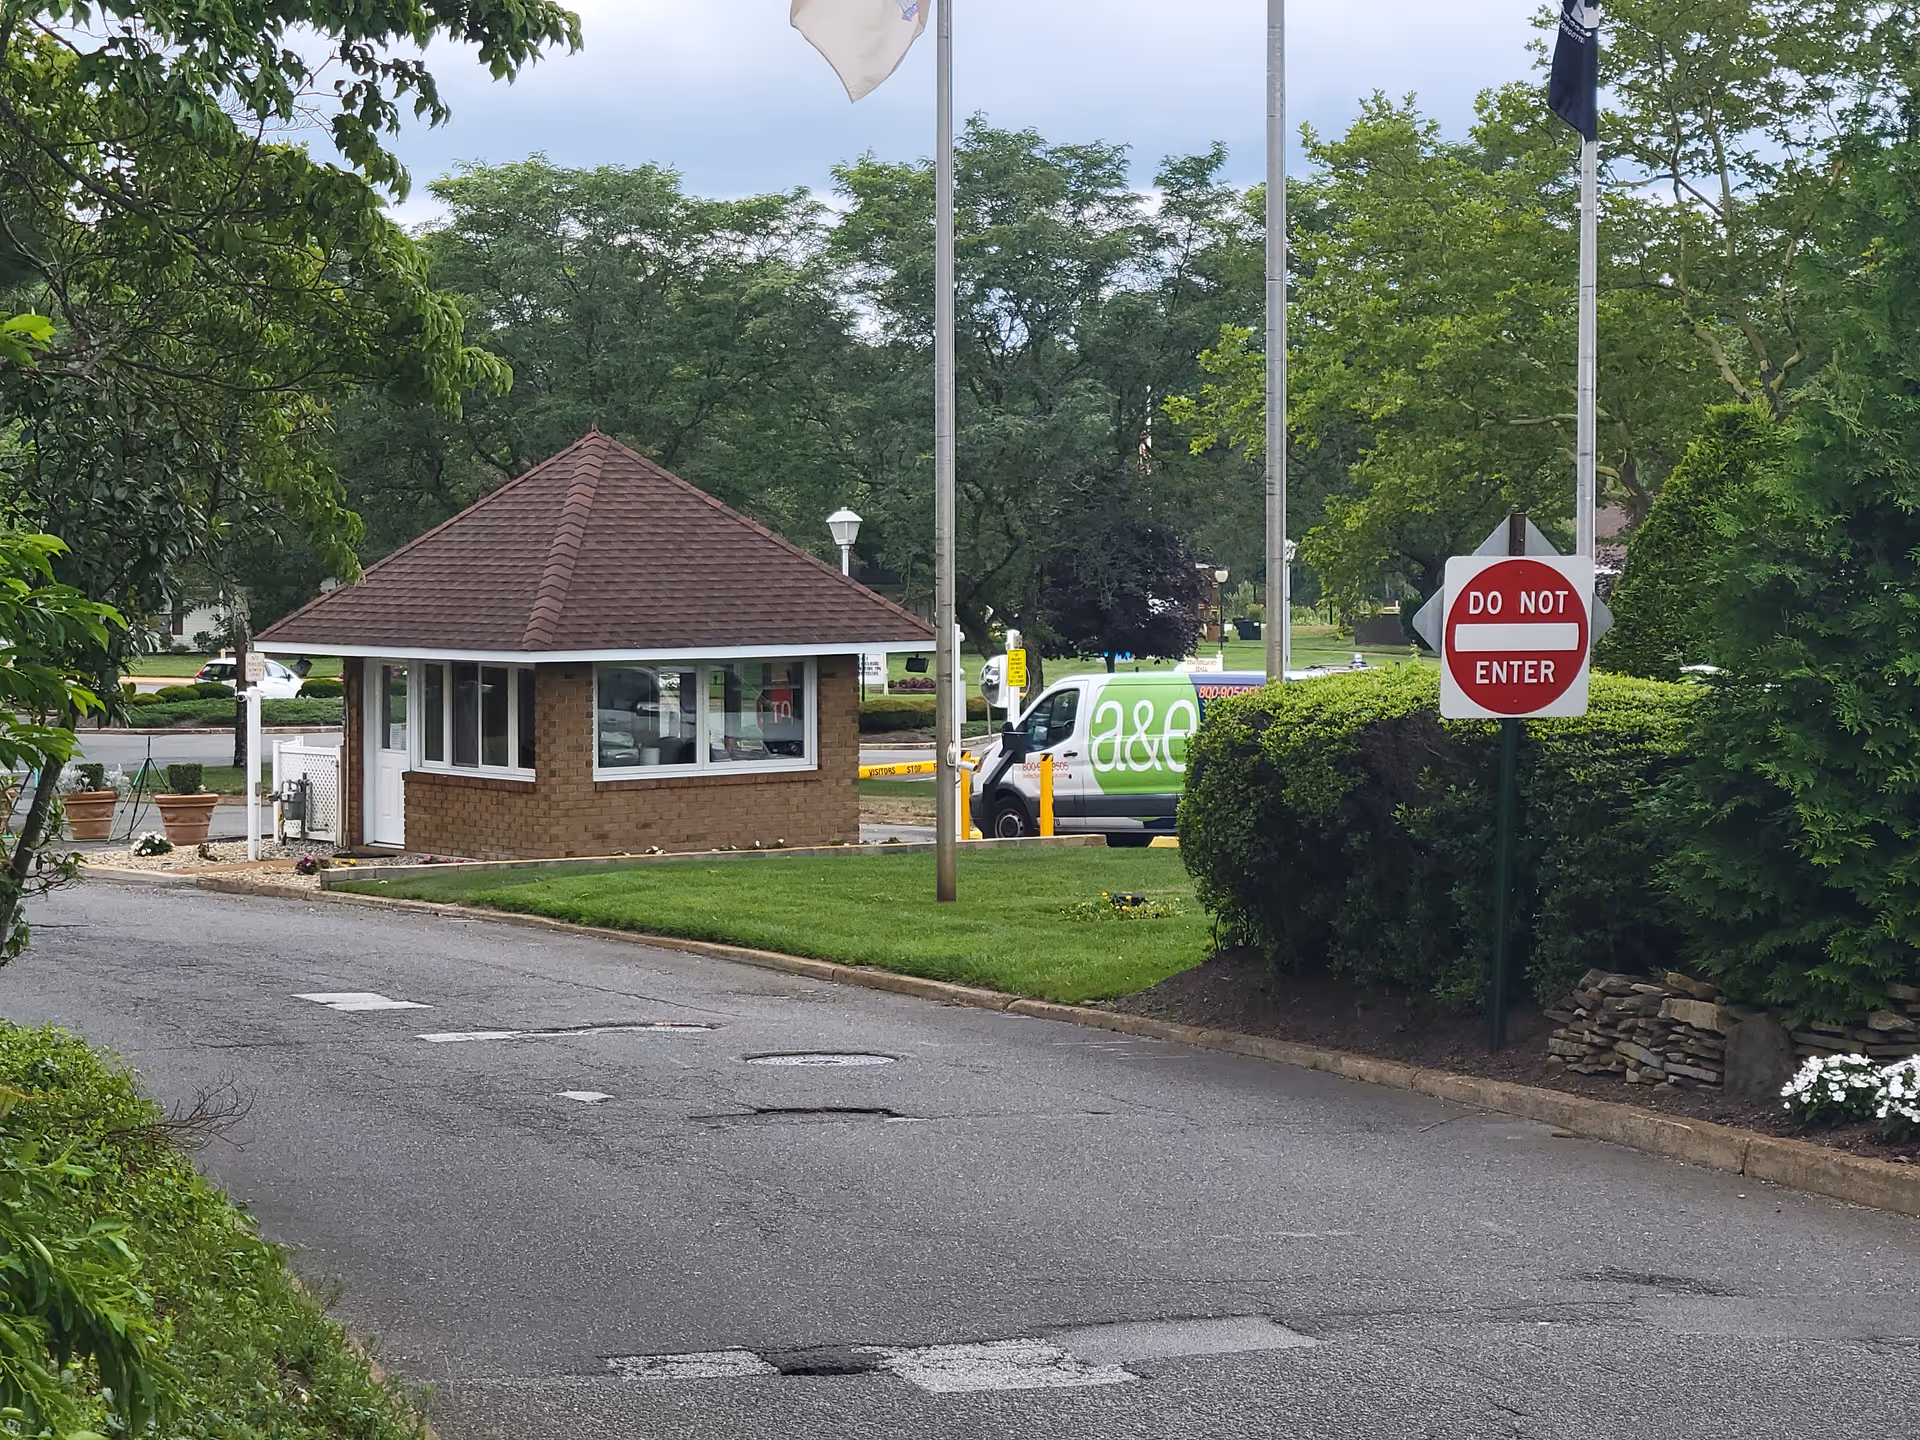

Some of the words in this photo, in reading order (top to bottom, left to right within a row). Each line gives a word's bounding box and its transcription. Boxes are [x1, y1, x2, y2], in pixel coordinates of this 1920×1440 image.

[1469, 591, 1502, 614] DO
[1520, 590, 1568, 614] NOT
[1475, 660, 1555, 684] ENTER
[1091, 699, 1197, 773] a&e
[868, 766, 896, 777] VISITORS
[906, 764, 922, 774] STOP
